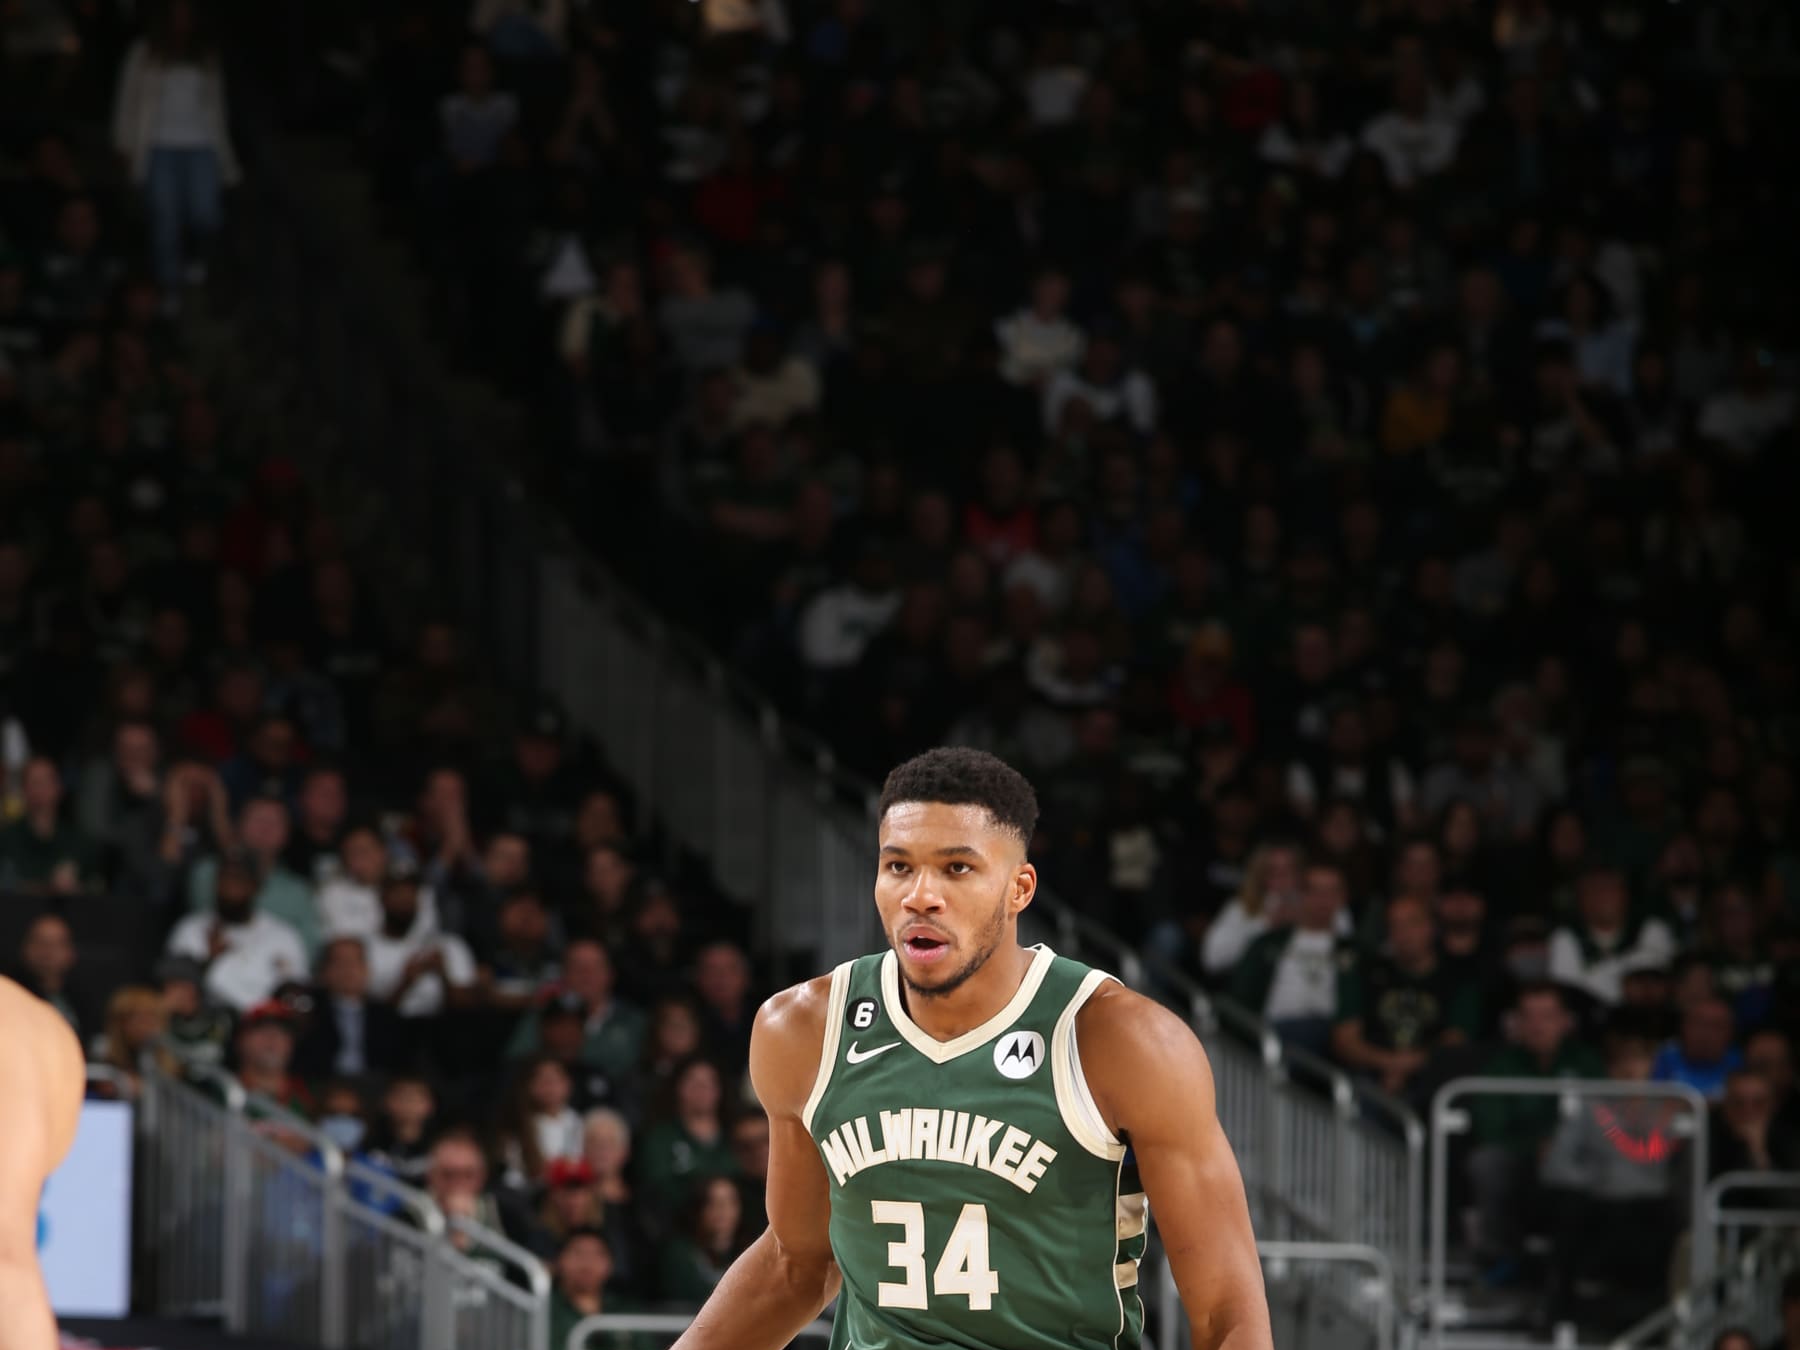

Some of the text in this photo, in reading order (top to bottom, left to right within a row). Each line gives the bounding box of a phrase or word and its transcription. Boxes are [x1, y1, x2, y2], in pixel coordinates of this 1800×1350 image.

[854, 1002, 875, 1028] 6
[821, 1108, 1058, 1194] MILWAUKEE
[871, 1200, 999, 1311] 34
